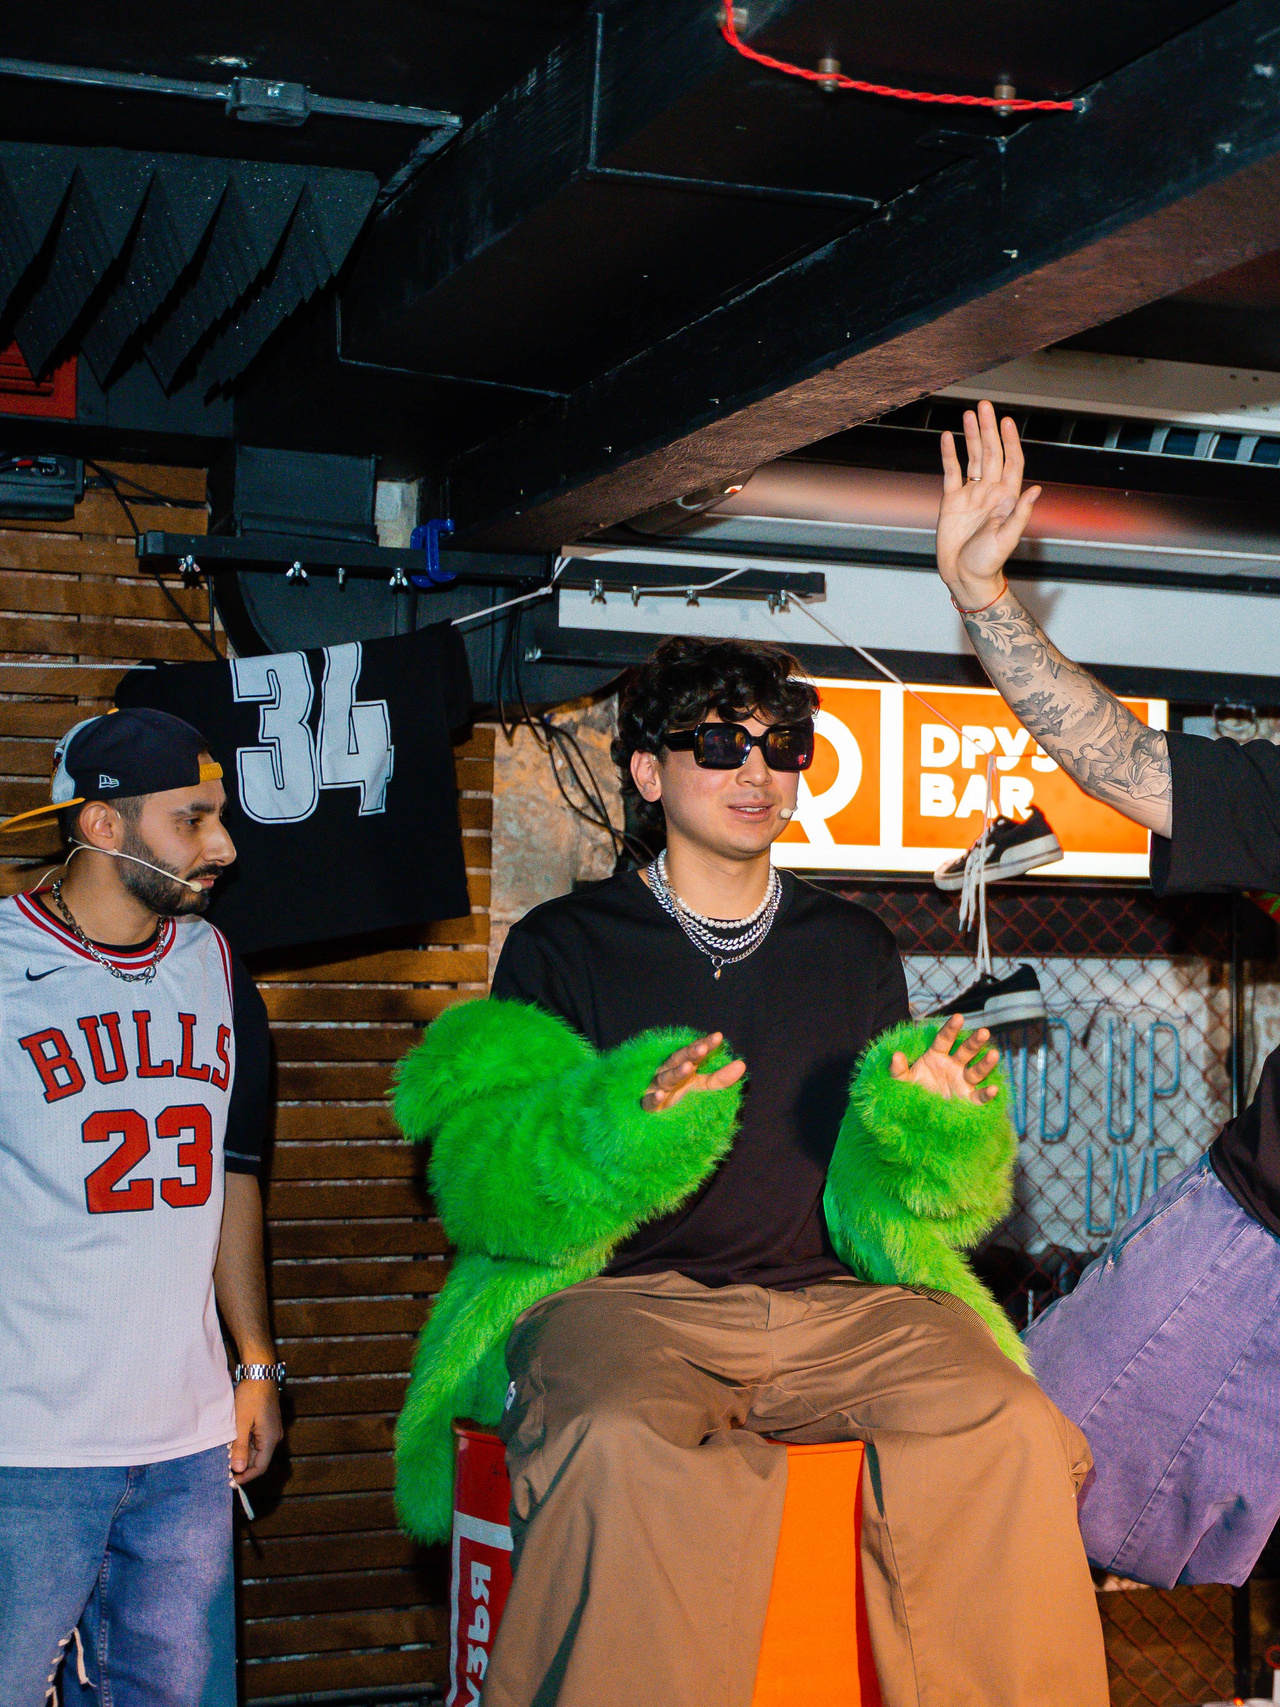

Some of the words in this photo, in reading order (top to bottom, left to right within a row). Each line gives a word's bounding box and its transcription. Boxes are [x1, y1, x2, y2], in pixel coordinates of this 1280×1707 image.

[229, 641, 394, 825] 34
[919, 773, 1035, 820] BAR
[18, 1010, 231, 1104] BULLS
[1106, 1017, 1180, 1142] UP
[81, 1103, 213, 1214] 23
